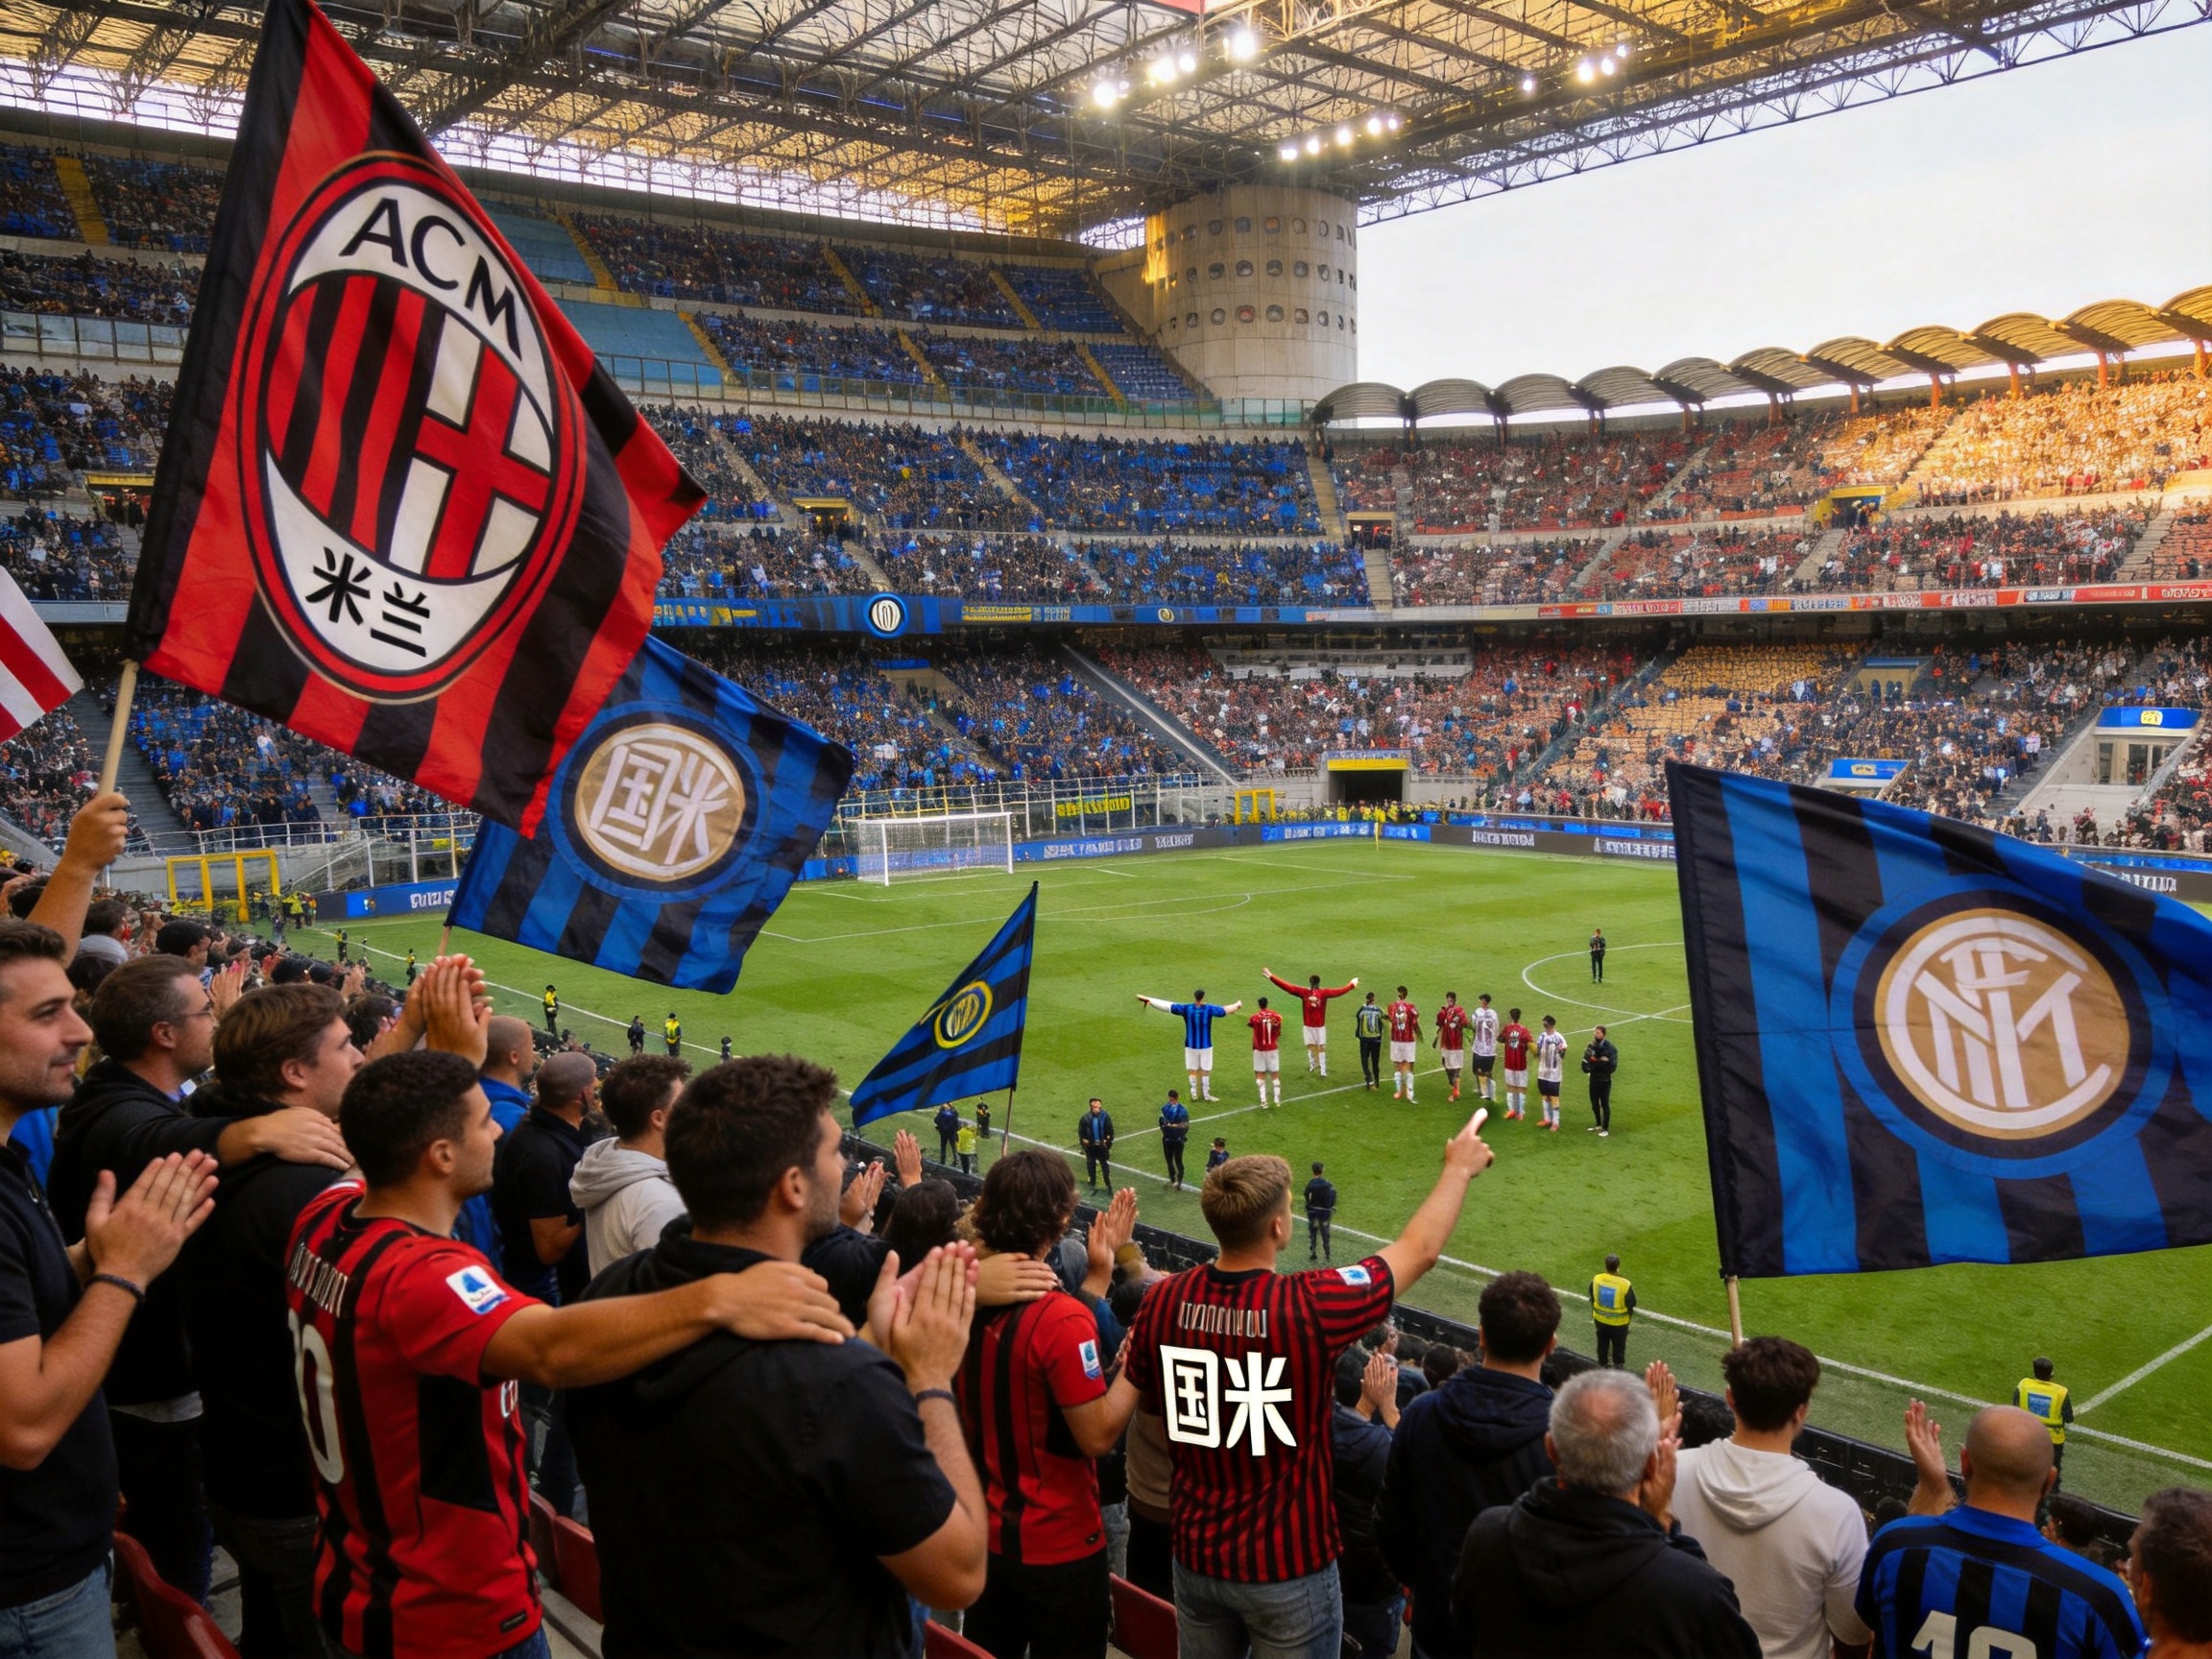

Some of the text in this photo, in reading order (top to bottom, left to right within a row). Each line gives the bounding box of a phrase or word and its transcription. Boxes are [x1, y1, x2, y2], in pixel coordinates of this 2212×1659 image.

[338, 198, 522, 362] ACM
[305, 546, 431, 658] 米兰
[589, 742, 730, 865] 国米
[1159, 1344, 1297, 1456] 国米
